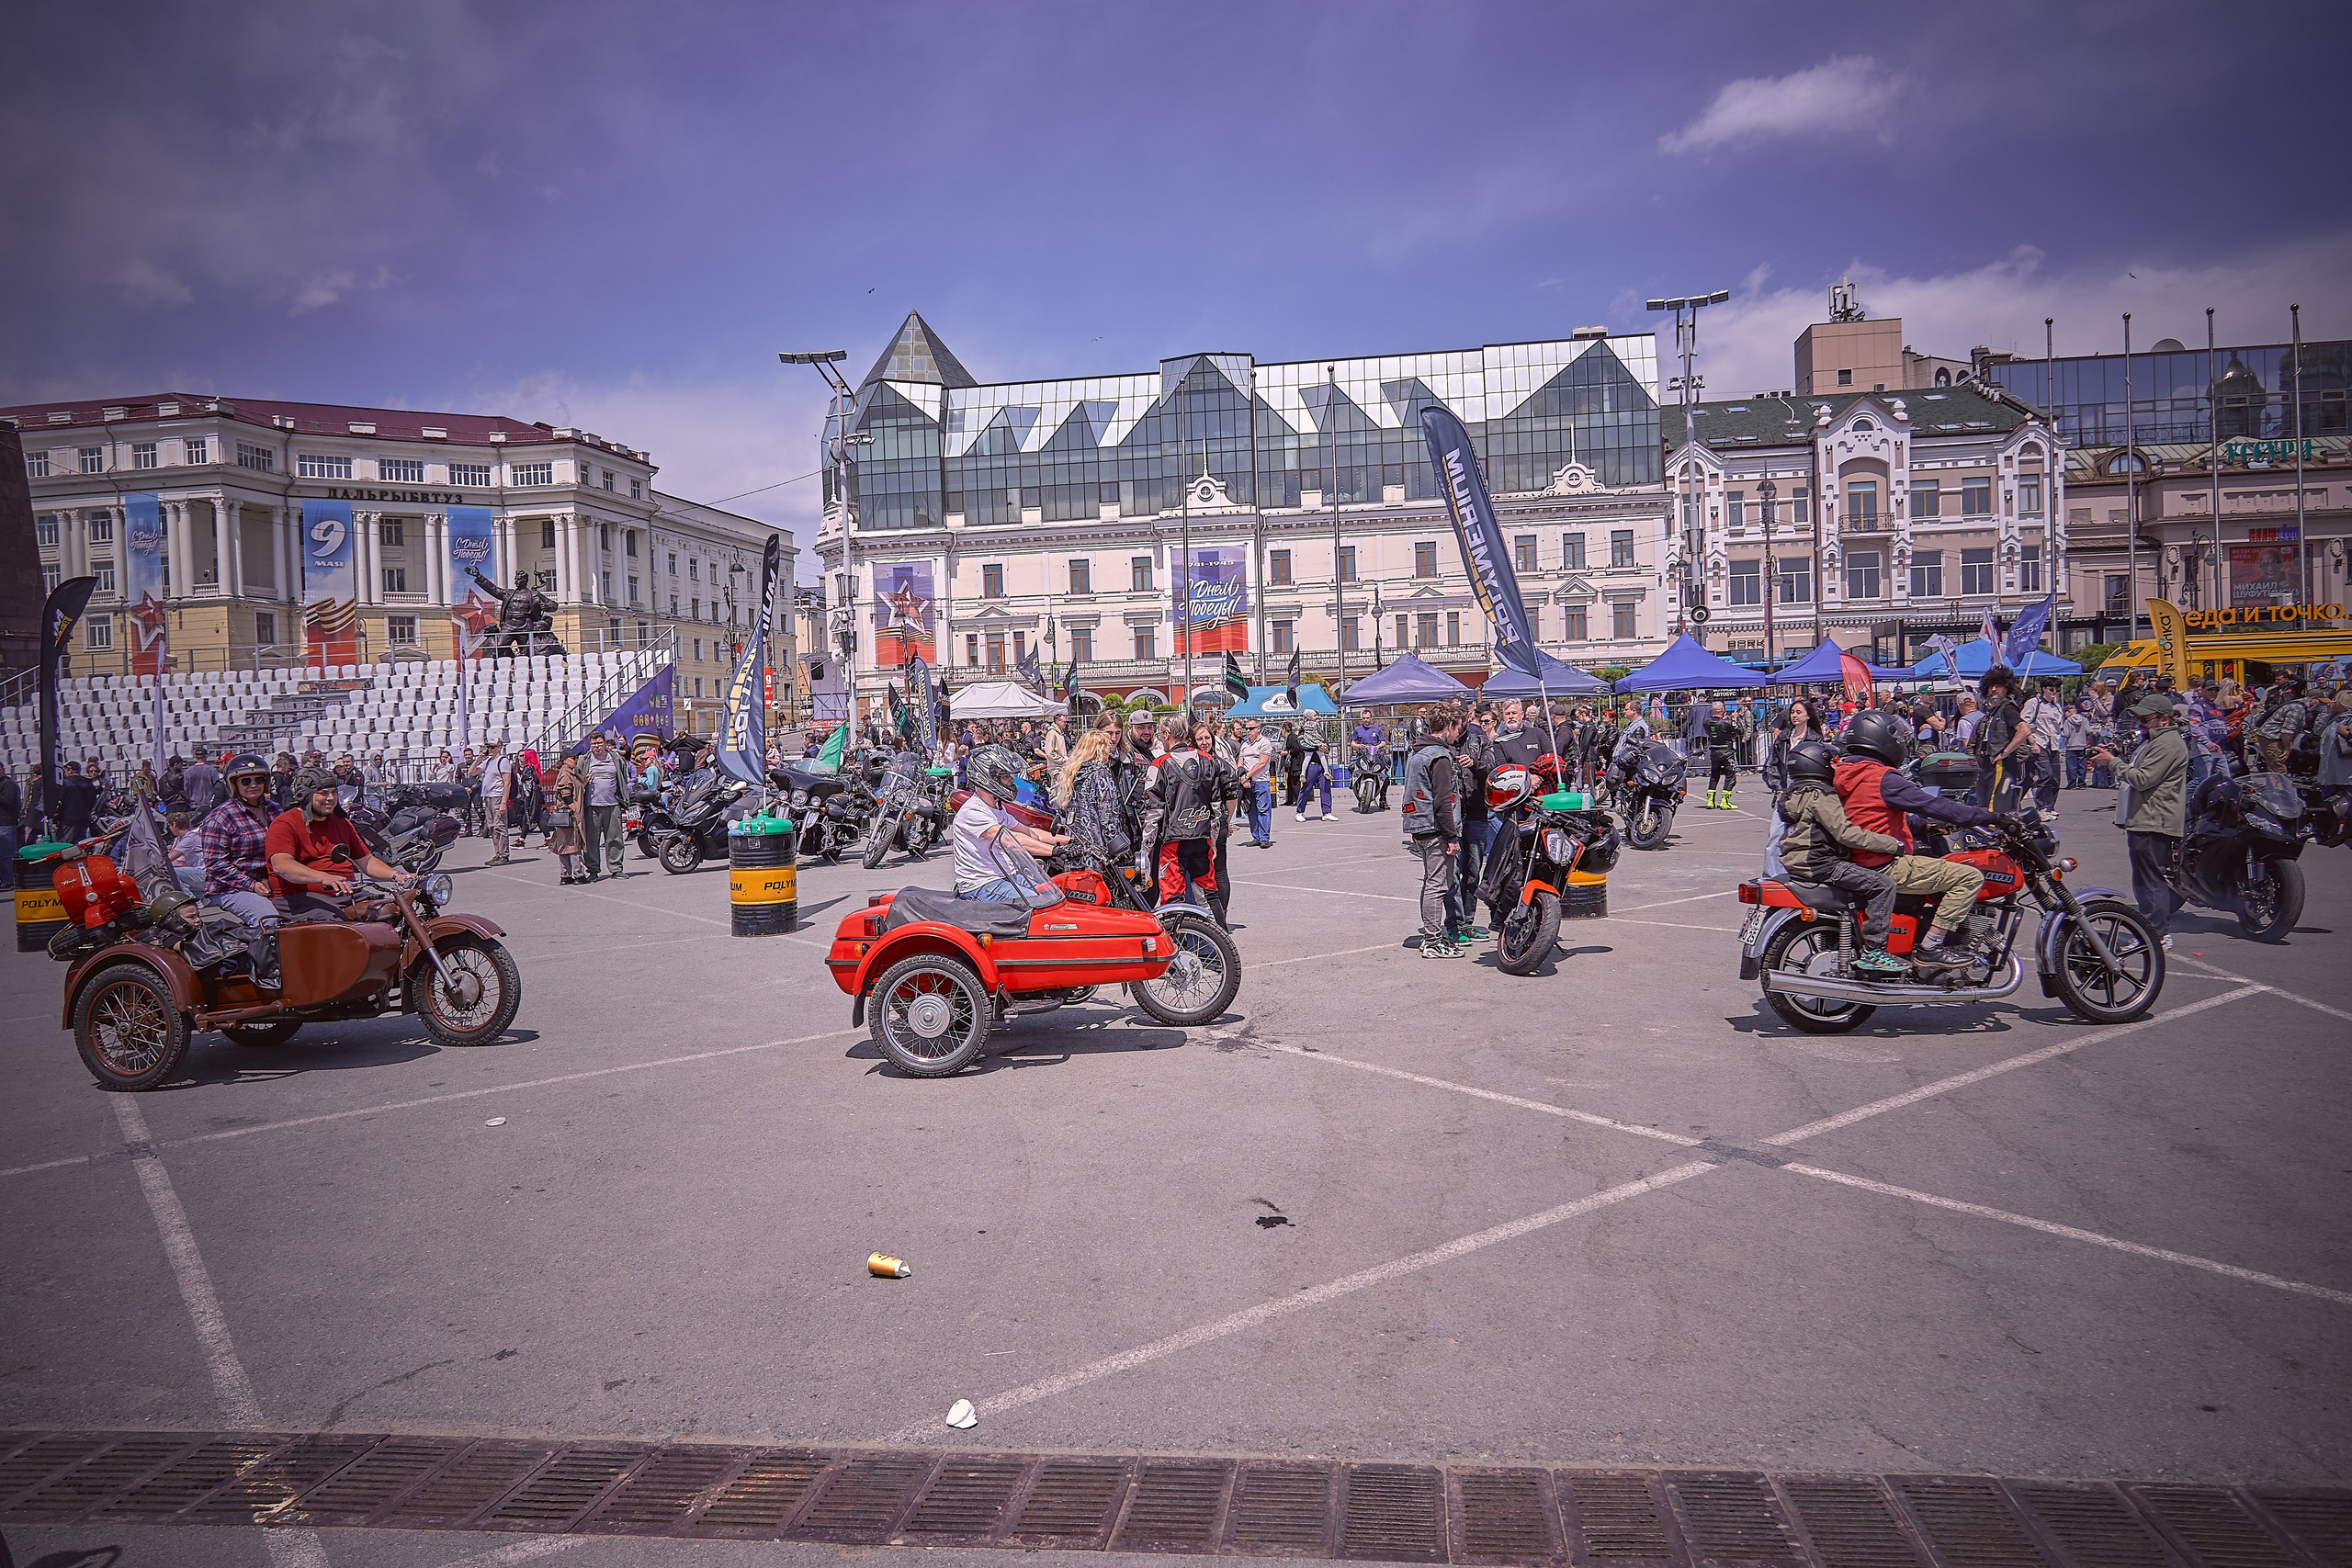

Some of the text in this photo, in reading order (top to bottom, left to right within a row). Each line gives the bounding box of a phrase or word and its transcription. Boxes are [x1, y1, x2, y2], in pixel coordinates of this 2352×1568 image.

[2224, 438, 2312, 466] УССУРИ
[327, 488, 463, 504] ДАЛЬРЫБВТУЗ
[311, 520, 346, 557] 9
[313, 559, 345, 569] МАЯ
[2233, 581, 2278, 591] МИХАИЛ
[2185, 603, 2351, 629] еда и точка.
[1727, 638, 1766, 649] BORK
[765, 674, 772, 685] 9
